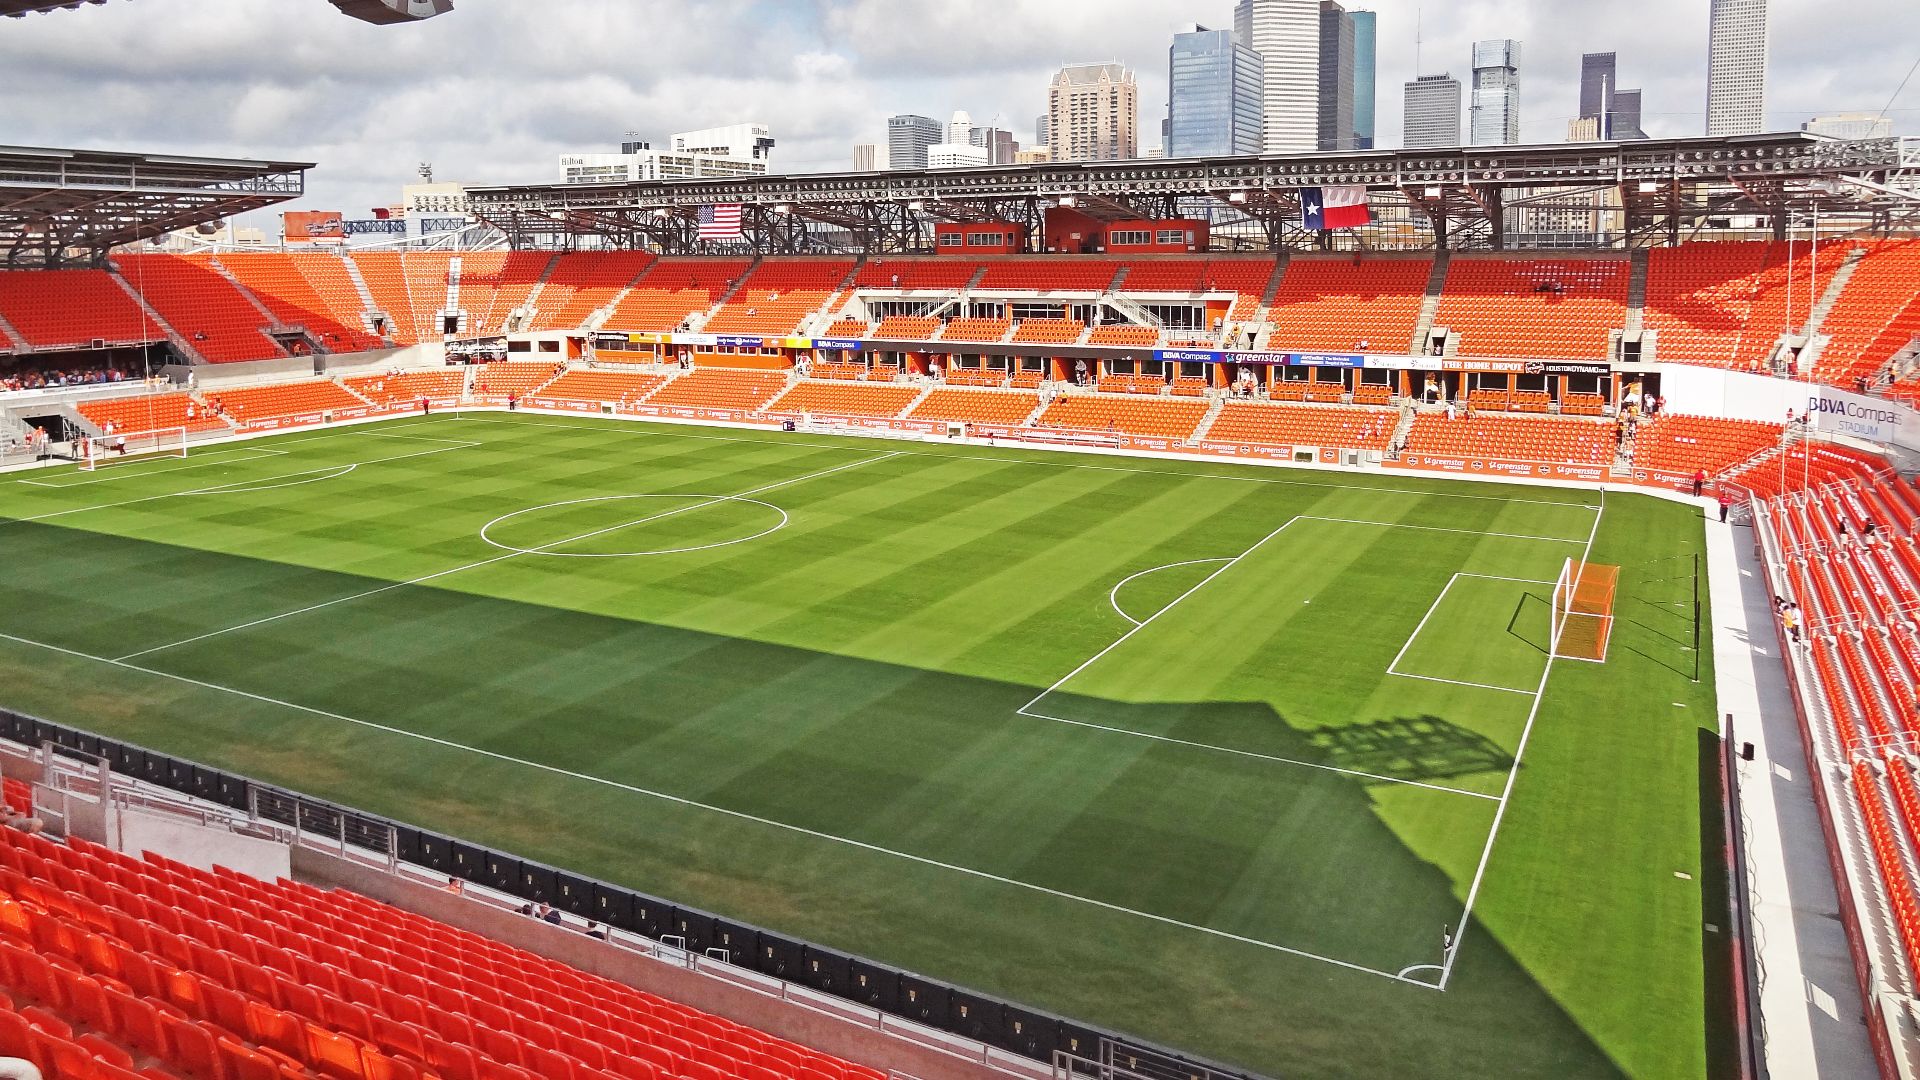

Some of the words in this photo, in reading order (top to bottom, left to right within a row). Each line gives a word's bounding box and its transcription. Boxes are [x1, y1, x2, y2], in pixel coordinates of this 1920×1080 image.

[832, 342, 855, 350] Compass
[1162, 351, 1180, 359] BBVA
[1181, 352, 1211, 361] Compass
[1235, 352, 1285, 363] greenstar
[1443, 361, 1462, 369] THE
[1464, 361, 1490, 370] HOME
[1492, 362, 1524, 371] DEPOT
[1809, 397, 1846, 416] BBVA
[1838, 420, 1878, 436] STADIUM
[1431, 458, 1465, 466] greenstar
[1497, 463, 1532, 471] greenstar
[1564, 467, 1602, 476] greenstar
